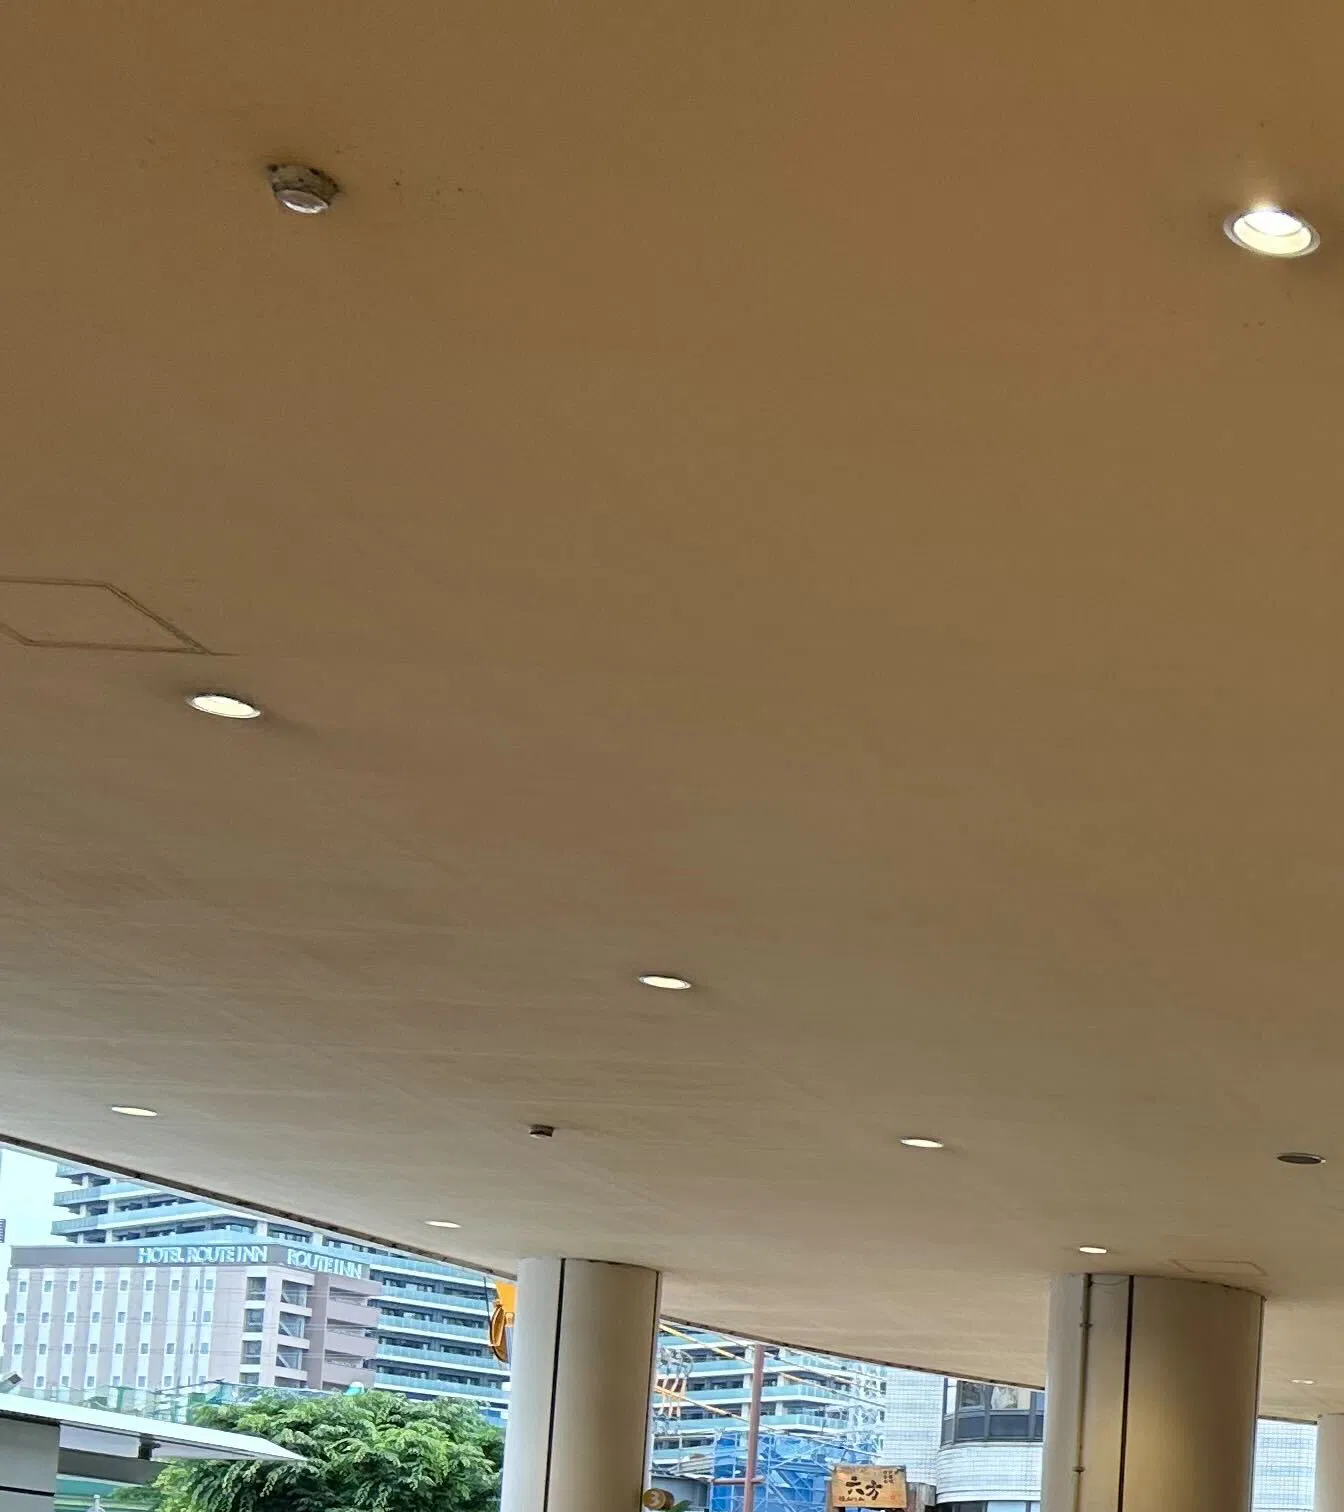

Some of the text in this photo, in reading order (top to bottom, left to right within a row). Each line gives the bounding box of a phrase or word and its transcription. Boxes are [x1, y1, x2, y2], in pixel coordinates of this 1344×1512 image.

[137, 1245, 268, 1264] HOTEL ROUTE INN
[287, 1248, 363, 1279] ROUTE INN
[845, 1476, 883, 1501] 六方
